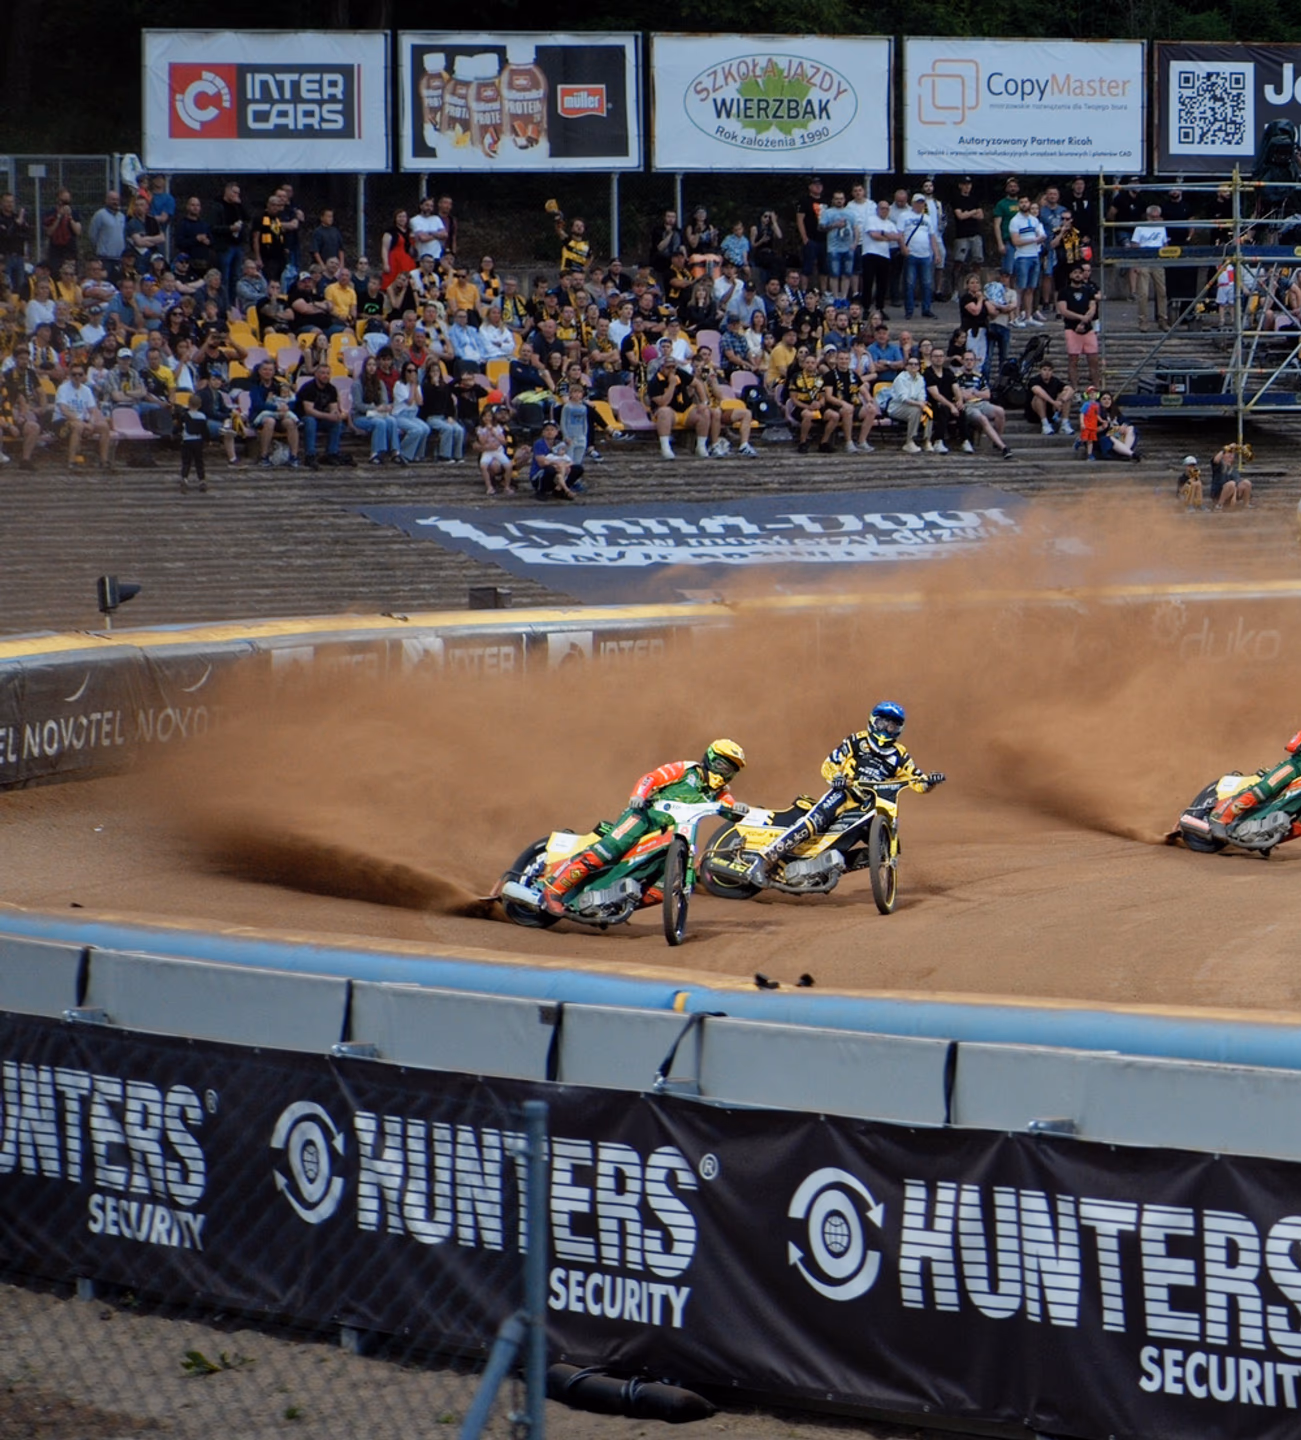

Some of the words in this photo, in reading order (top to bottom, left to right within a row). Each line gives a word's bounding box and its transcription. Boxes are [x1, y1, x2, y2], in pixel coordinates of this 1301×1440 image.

[246, 73, 343, 99] INTER
[693, 57, 777, 102] SZKOŁA
[783, 59, 848, 101] JAZDY
[986, 72, 1131, 101] CopyMaster
[563, 91, 600, 109] müller
[712, 97, 831, 120] WIERZBAK
[247, 103, 344, 130] CARS
[715, 125, 738, 142] Rok
[800, 126, 830, 145] 1990
[958, 136, 1028, 147] Autoryzowany
[1030, 137, 1065, 146] Partner
[1068, 136, 1093, 146] Ricoh
[23, 710, 125, 760] NOVOTEL
[88, 1193, 206, 1250] SECURITY
[547, 1266, 691, 1329] SECURITY
